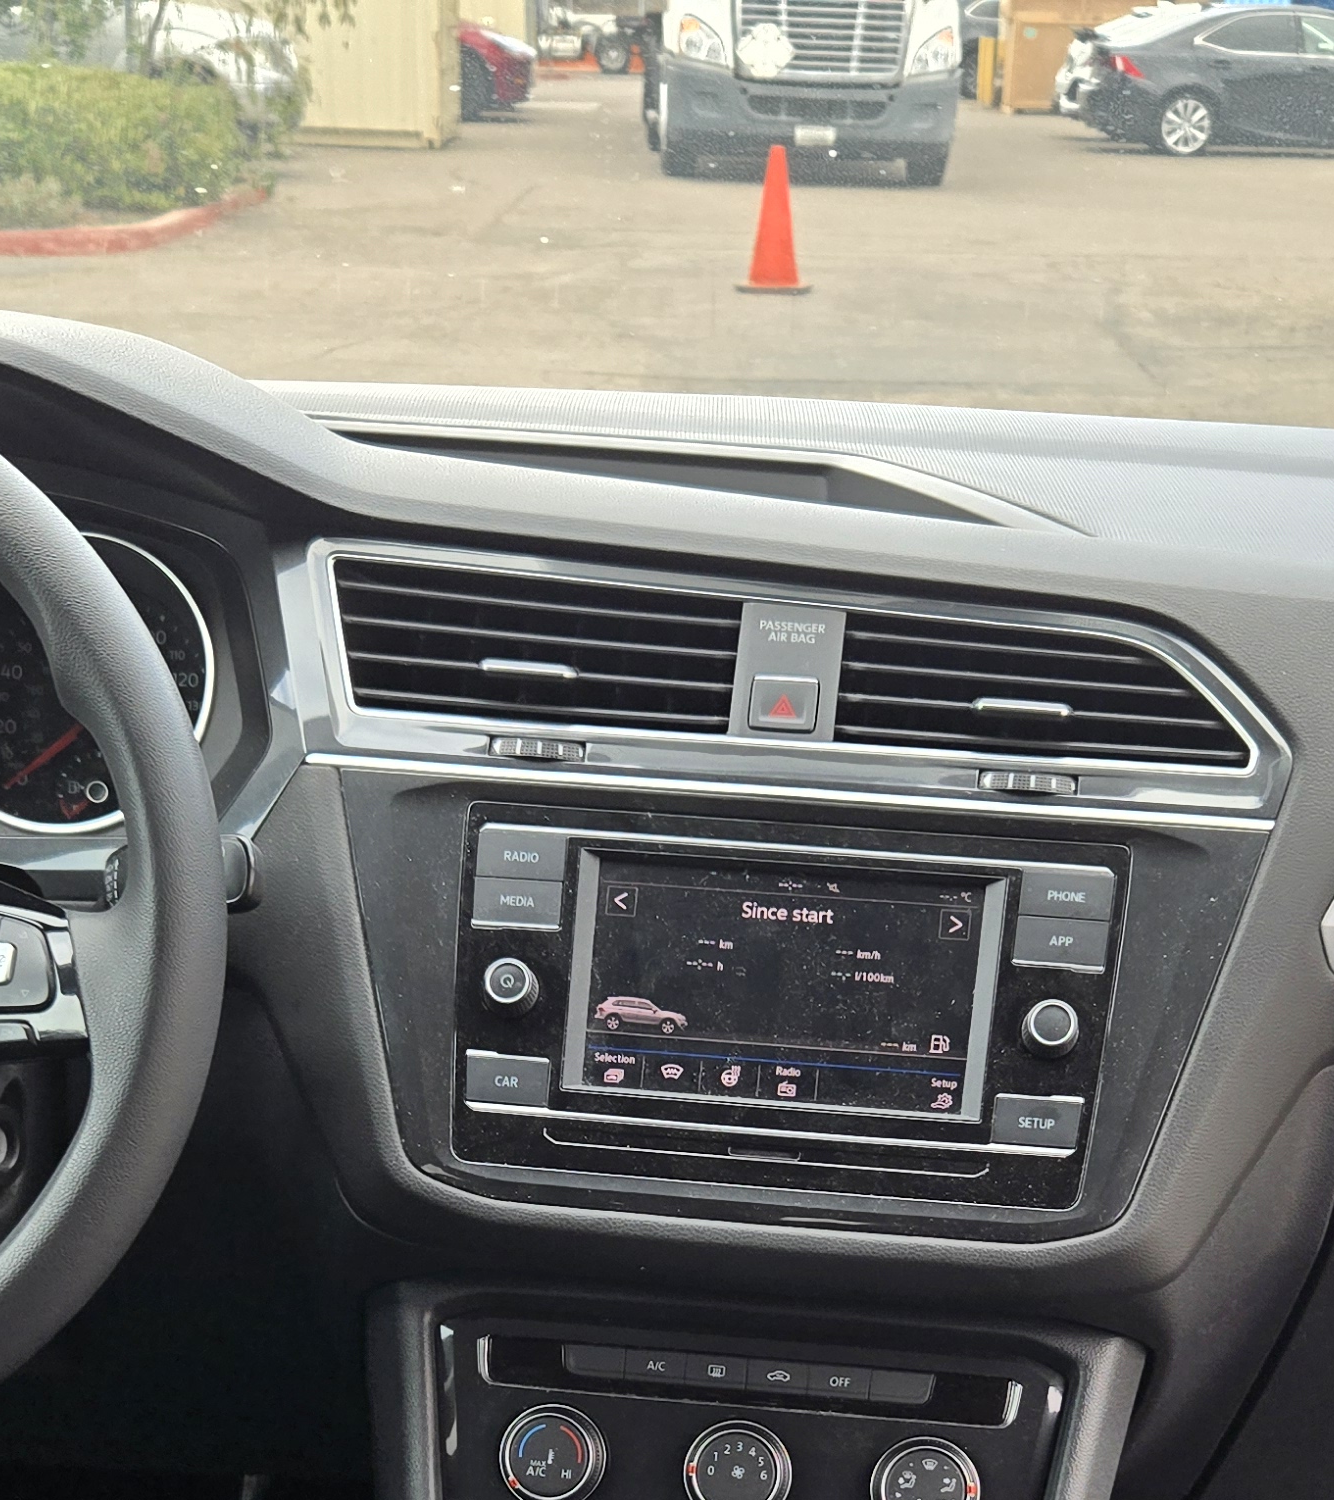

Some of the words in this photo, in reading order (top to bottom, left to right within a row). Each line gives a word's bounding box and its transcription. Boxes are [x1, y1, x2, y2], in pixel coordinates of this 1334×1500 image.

[759, 619, 826, 634] PASSENGER
[768, 632, 788, 643] AIR
[790, 632, 816, 644] BAG
[170, 650, 186, 661] 110
[0, 664, 22, 680] 40
[173, 672, 199, 688] 120
[503, 850, 540, 864] RADIO
[499, 894, 535, 908] MEDIA
[1047, 889, 1086, 903] PHONE
[741, 901, 788, 921] Since
[792, 908, 834, 925] start
[719, 938, 734, 950] km
[1049, 935, 1074, 947] APP
[856, 949, 881, 961] km/h
[901, 1041, 917, 1052] km
[593, 1052, 636, 1066] Selection
[775, 1066, 801, 1078] Radio
[930, 1077, 958, 1090] Setup
[494, 1075, 519, 1089] CAR
[1018, 1116, 1055, 1130] SETUP
[646, 1360, 666, 1372] A/C
[829, 1376, 851, 1388] OFF
[723, 1444, 731, 1455] 2
[736, 1441, 743, 1452] 3
[748, 1447, 756, 1457] 4
[529, 1459, 547, 1467] MAX
[713, 1452, 718, 1462] 1
[758, 1456, 765, 1467] 5
[526, 1466, 546, 1478] A/C
[560, 1469, 572, 1479] HI
[707, 1465, 715, 1476] 0
[760, 1470, 768, 1481] 6
